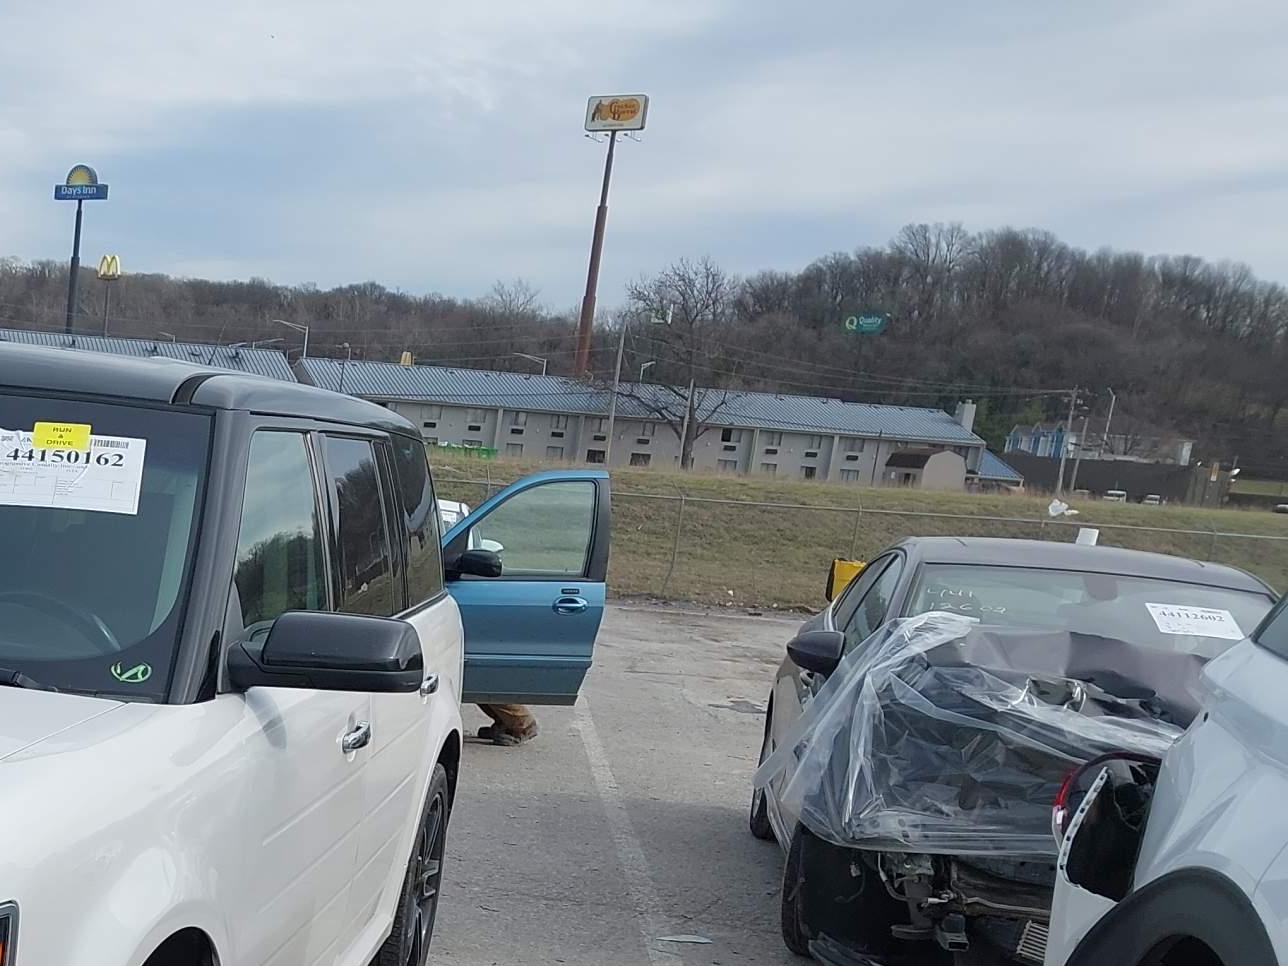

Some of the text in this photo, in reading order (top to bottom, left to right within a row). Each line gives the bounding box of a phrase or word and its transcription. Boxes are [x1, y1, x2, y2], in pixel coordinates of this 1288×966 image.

[61, 186, 97, 196] Days Inn
[6, 448, 124, 467] 44150162
